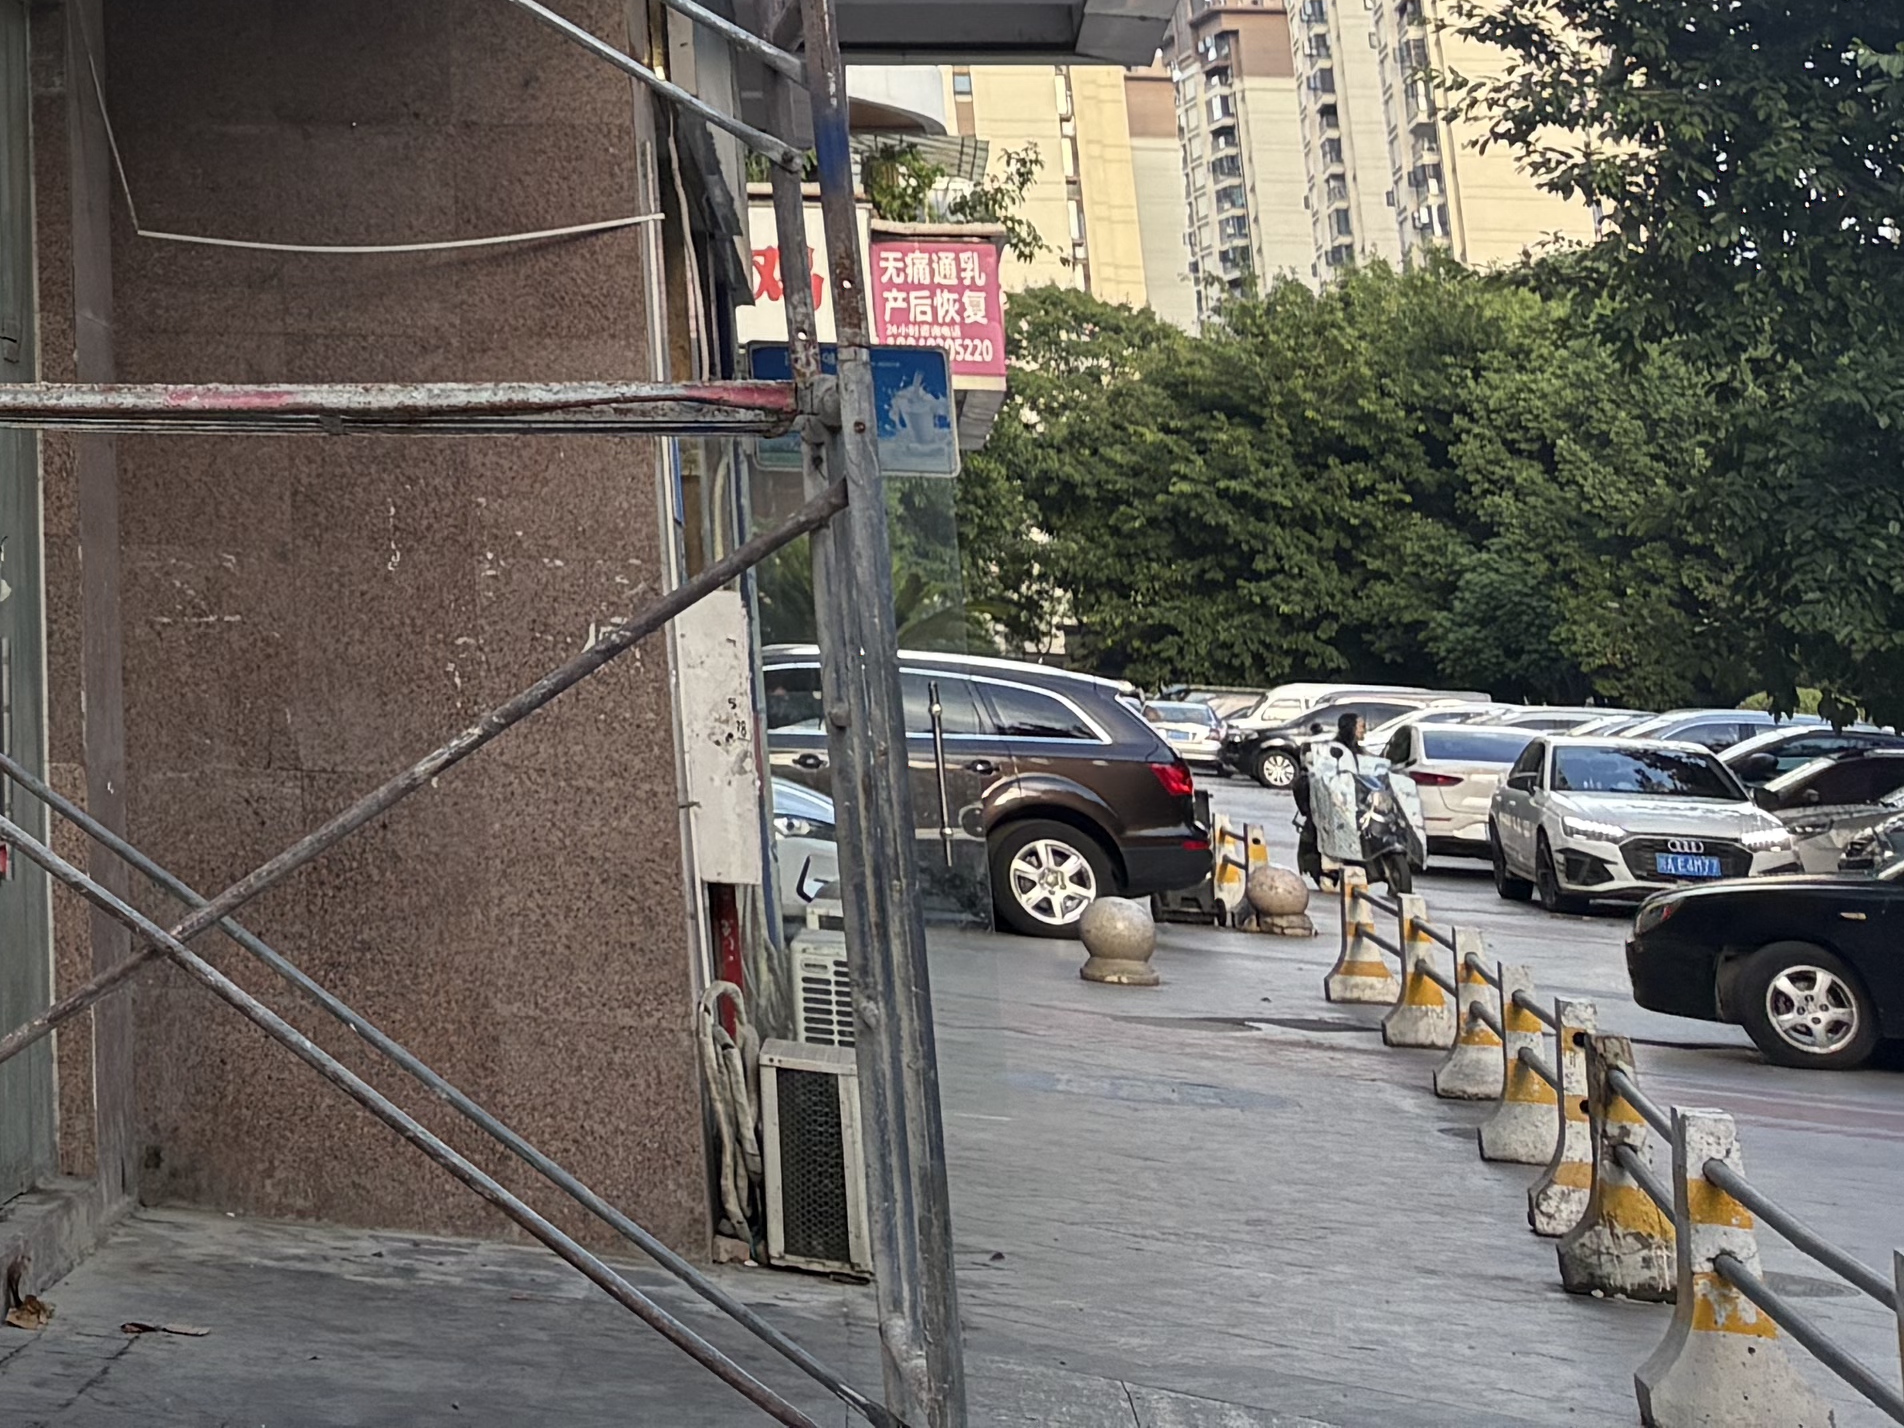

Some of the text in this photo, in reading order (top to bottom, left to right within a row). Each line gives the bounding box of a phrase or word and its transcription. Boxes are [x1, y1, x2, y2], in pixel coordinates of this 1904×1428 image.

[879, 250, 987, 287] 无痛通乳
[882, 289, 988, 325] 产后恢复
